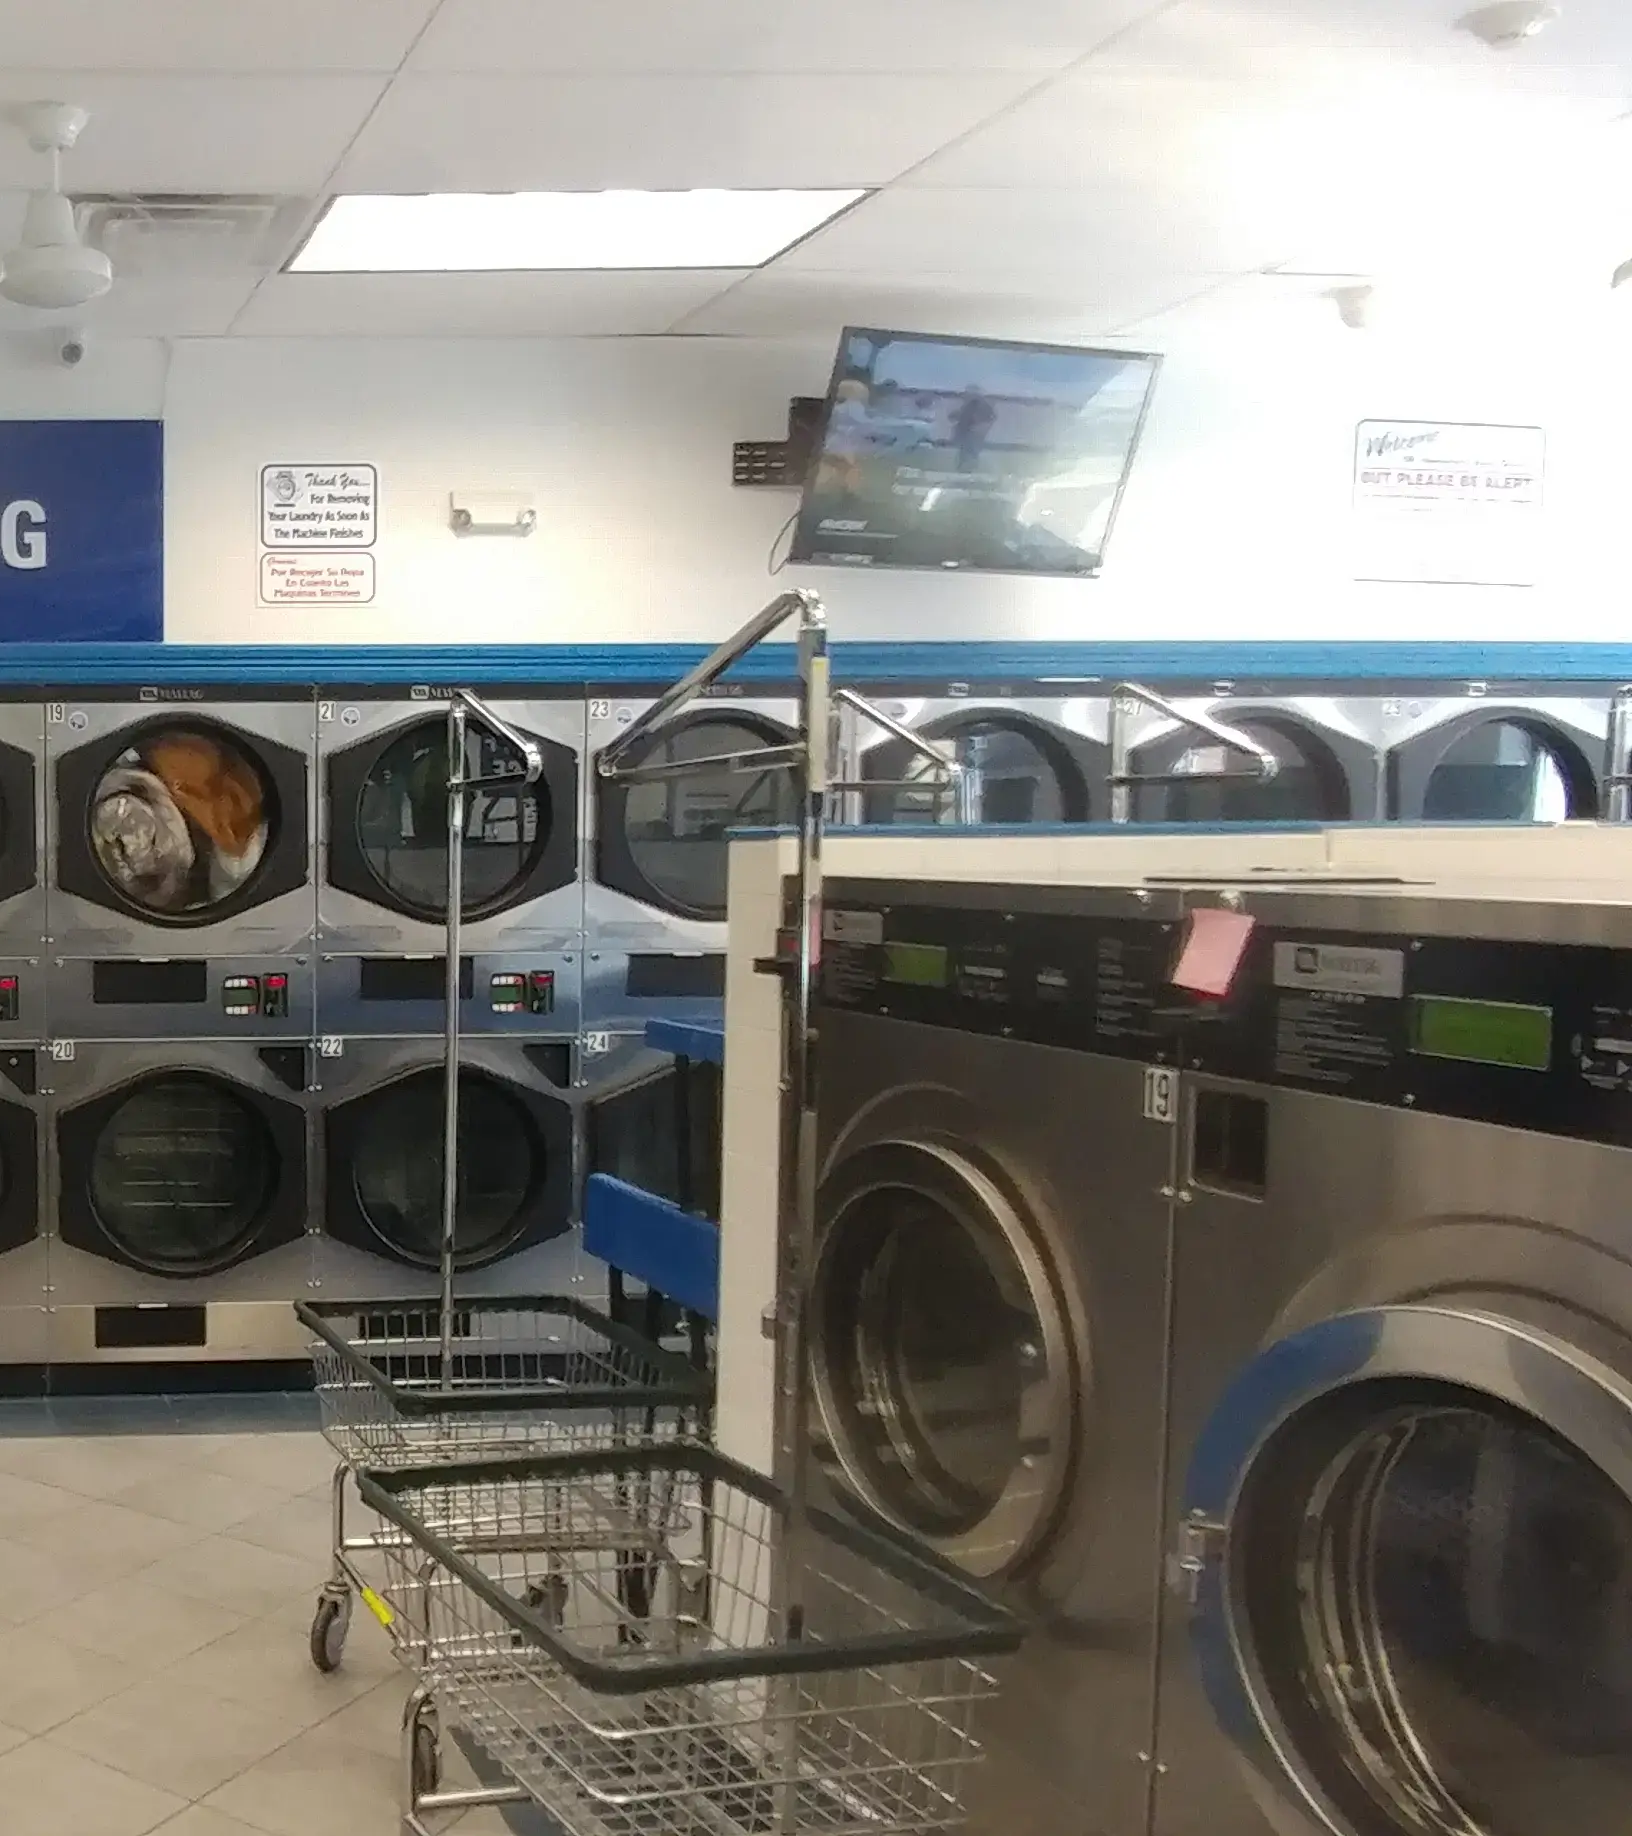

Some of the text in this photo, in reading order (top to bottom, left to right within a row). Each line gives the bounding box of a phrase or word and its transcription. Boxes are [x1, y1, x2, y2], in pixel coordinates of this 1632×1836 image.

[305, 473, 337, 487] Thank
[310, 492, 370, 506] For Removing
[267, 510, 370, 524] Your Laundry As Soon As
[274, 526, 364, 539] The Machine Finishes
[49, 704, 63, 721] 19
[321, 703, 335, 719] 21
[591, 701, 609, 717] 23
[55, 1042, 72, 1059] 20
[323, 1039, 341, 1055] 22
[588, 1034, 605, 1051] 24
[1149, 1073, 1169, 1118] 19
